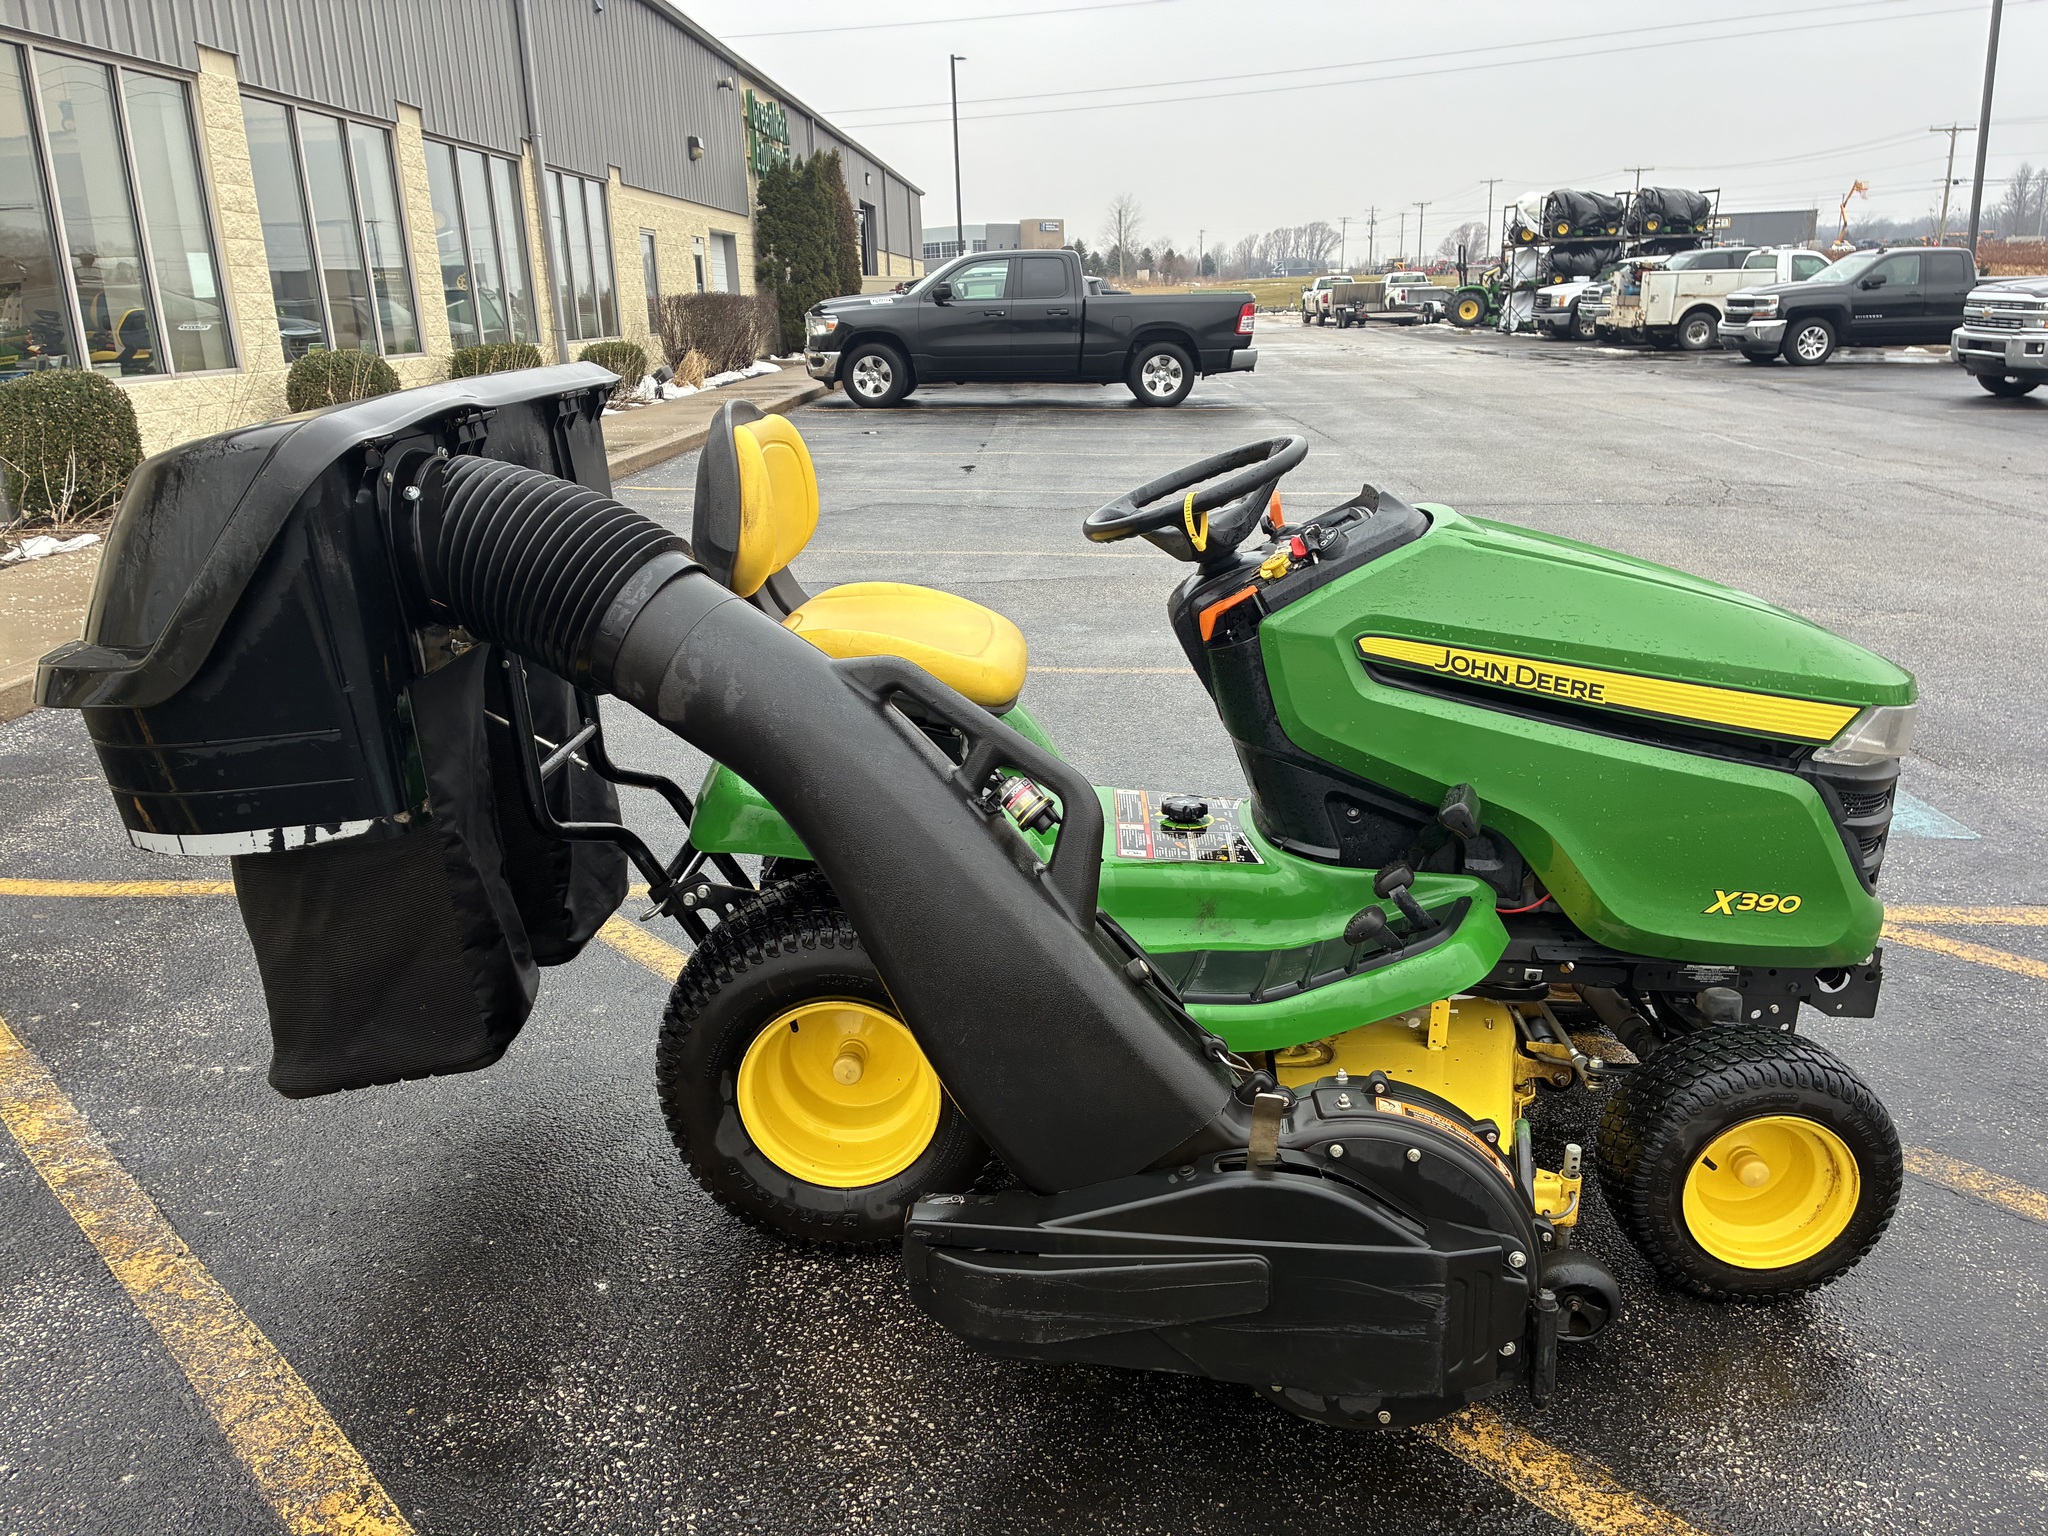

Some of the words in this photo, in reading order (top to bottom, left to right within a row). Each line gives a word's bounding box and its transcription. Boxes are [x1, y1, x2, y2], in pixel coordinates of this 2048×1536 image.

[1434, 649, 1509, 682] JOHN
[1515, 664, 1605, 702] DEERE
[1700, 888, 1803, 916] X390
